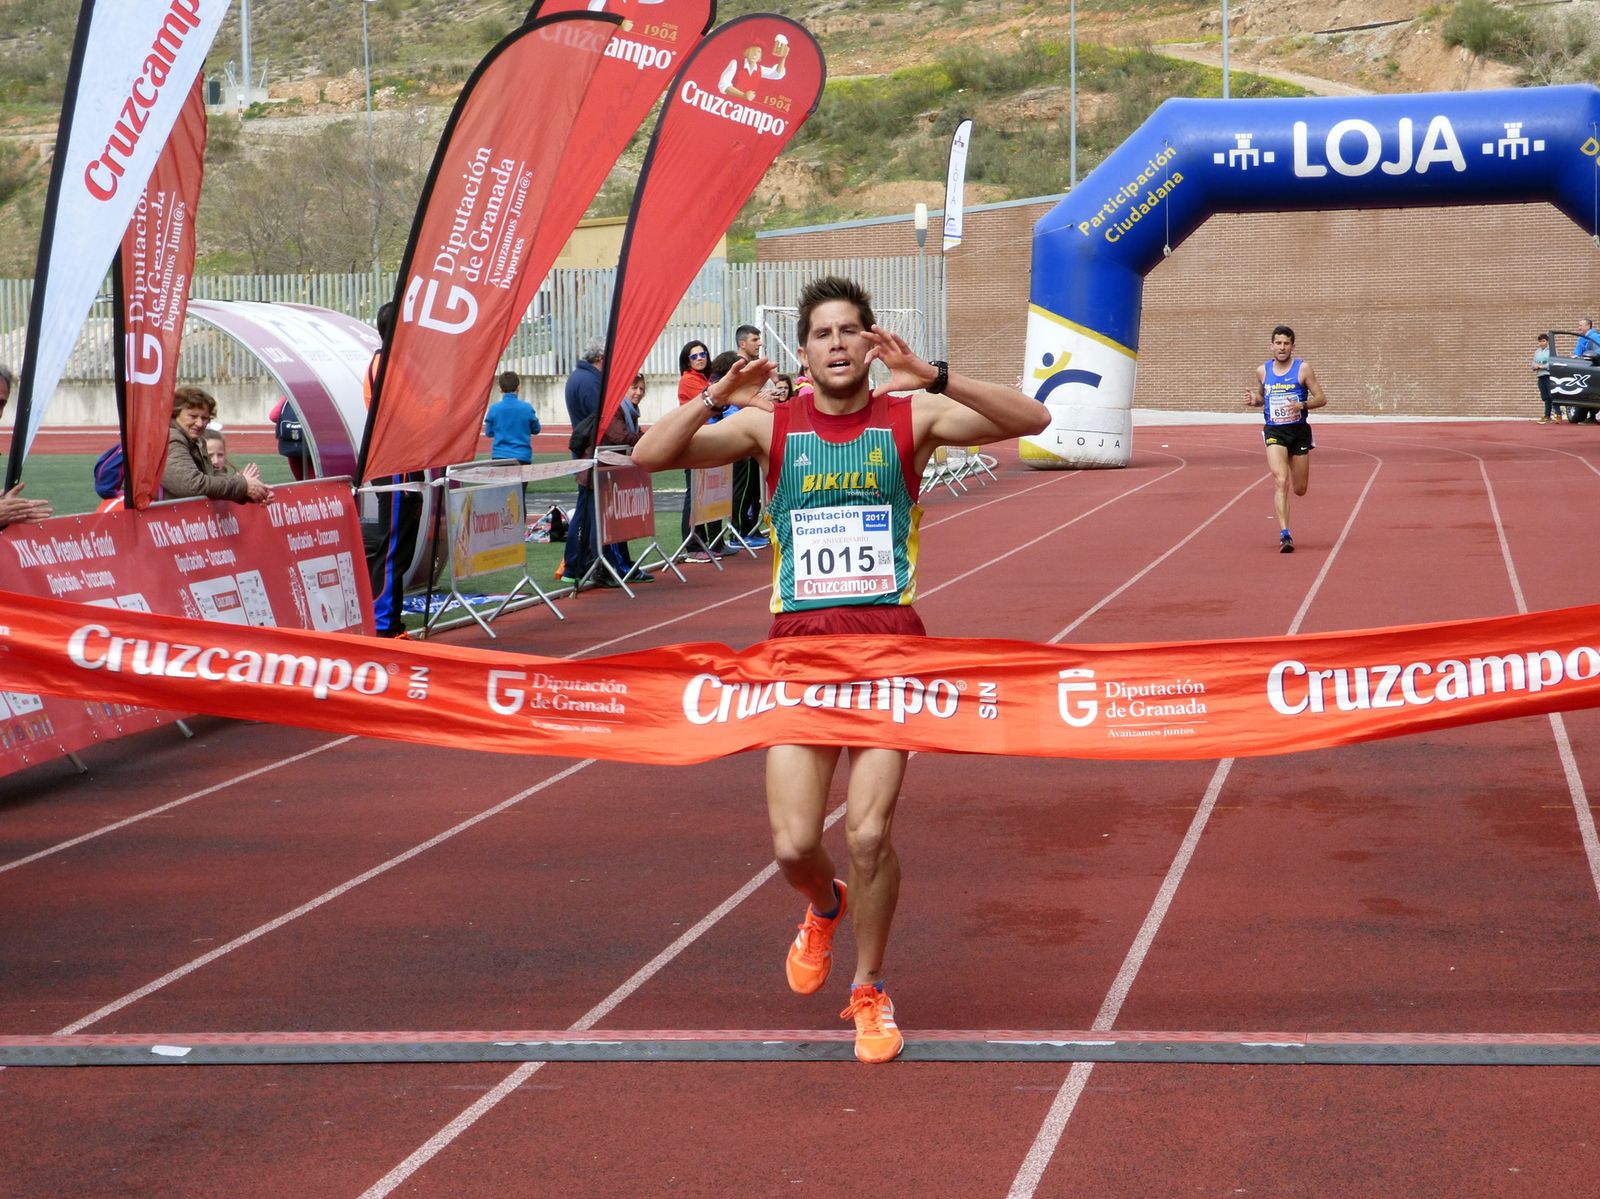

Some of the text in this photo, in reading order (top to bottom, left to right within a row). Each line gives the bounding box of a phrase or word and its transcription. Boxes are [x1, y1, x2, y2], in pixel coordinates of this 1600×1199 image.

[644, 24, 677, 42] 1904
[681, 80, 785, 136] Cruzcampo
[763, 95, 792, 113] 1904
[1293, 115, 1467, 179] LOJA
[1078, 147, 1177, 236] Participación
[1105, 172, 1184, 243] Ciudadana
[433, 147, 492, 277] Diputación
[460, 158, 515, 283] de Granada
[489, 170, 533, 287] Avanzamos Junt@s
[160, 200, 185, 316] anzamos Junt@s
[500, 237, 525, 289] Deportes
[146, 299, 160, 328] de
[162, 273, 185, 333] Deportes
[1056, 435, 1121, 448] LOJA
[802, 471, 879, 494] BIKILA
[794, 510, 860, 523] Diputación
[796, 524, 846, 536] Granada
[11, 530, 117, 568] XXX Gran Premio de Fondo
[800, 546, 875, 575] 1015
[803, 579, 877, 594] Cruzcampo
[67, 624, 430, 701] Cruzcampo SIN
[532, 672, 628, 695] Diputación
[1104, 679, 1206, 701] Diputación
[1266, 645, 1600, 715] Cruzcampo
[530, 692, 625, 715] de Granada
[682, 673, 998, 724] Cruzcampo SIN
[1105, 699, 1208, 719] de Granada
[1107, 726, 1195, 738] Avanzamos juntos
